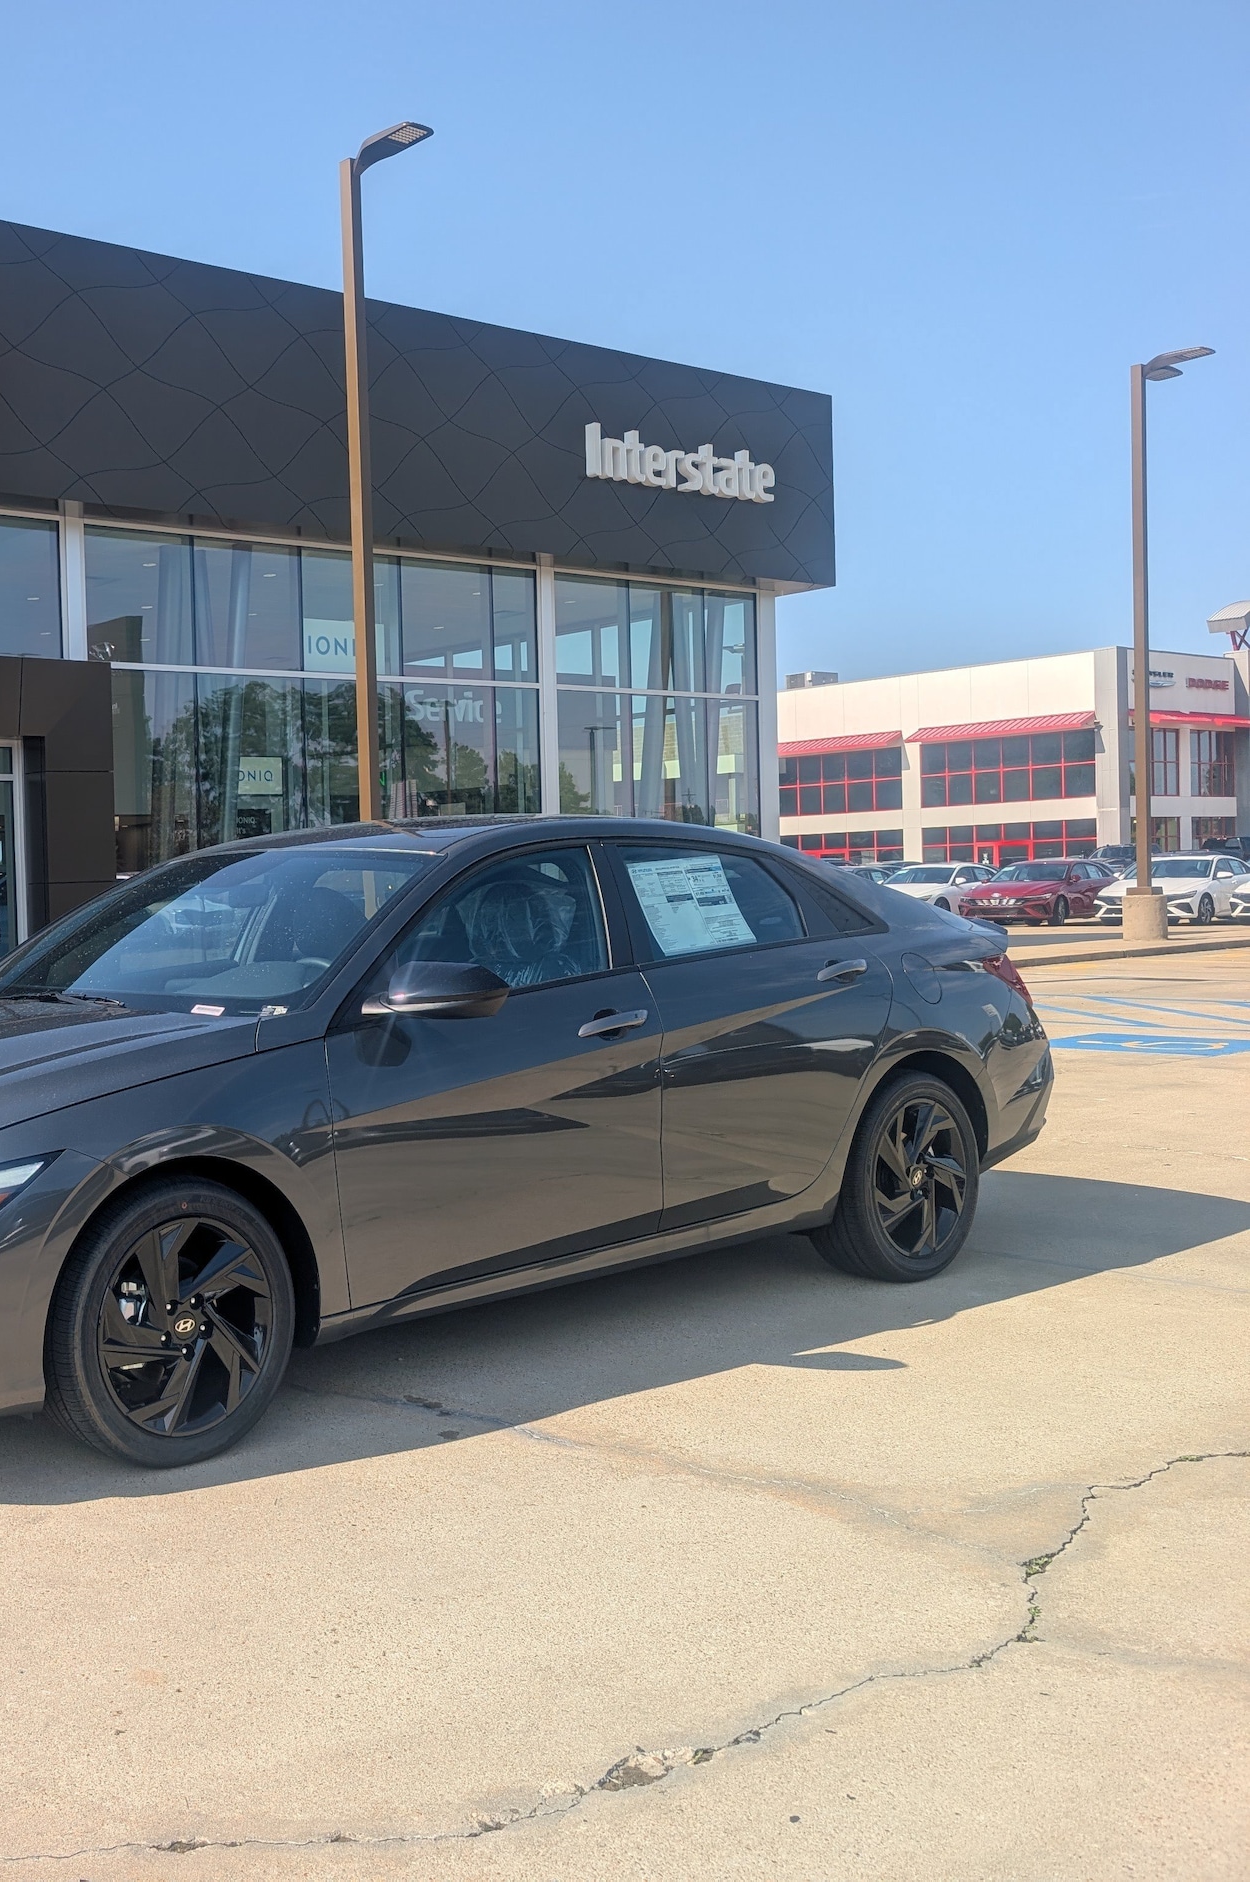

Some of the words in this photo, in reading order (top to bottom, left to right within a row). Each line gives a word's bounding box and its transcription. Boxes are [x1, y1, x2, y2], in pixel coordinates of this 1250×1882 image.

[584, 421, 776, 503] Interstate
[307, 635, 355, 656] IONI
[1187, 678, 1229, 690] DODGE
[238, 770, 273, 782] ONIQ
